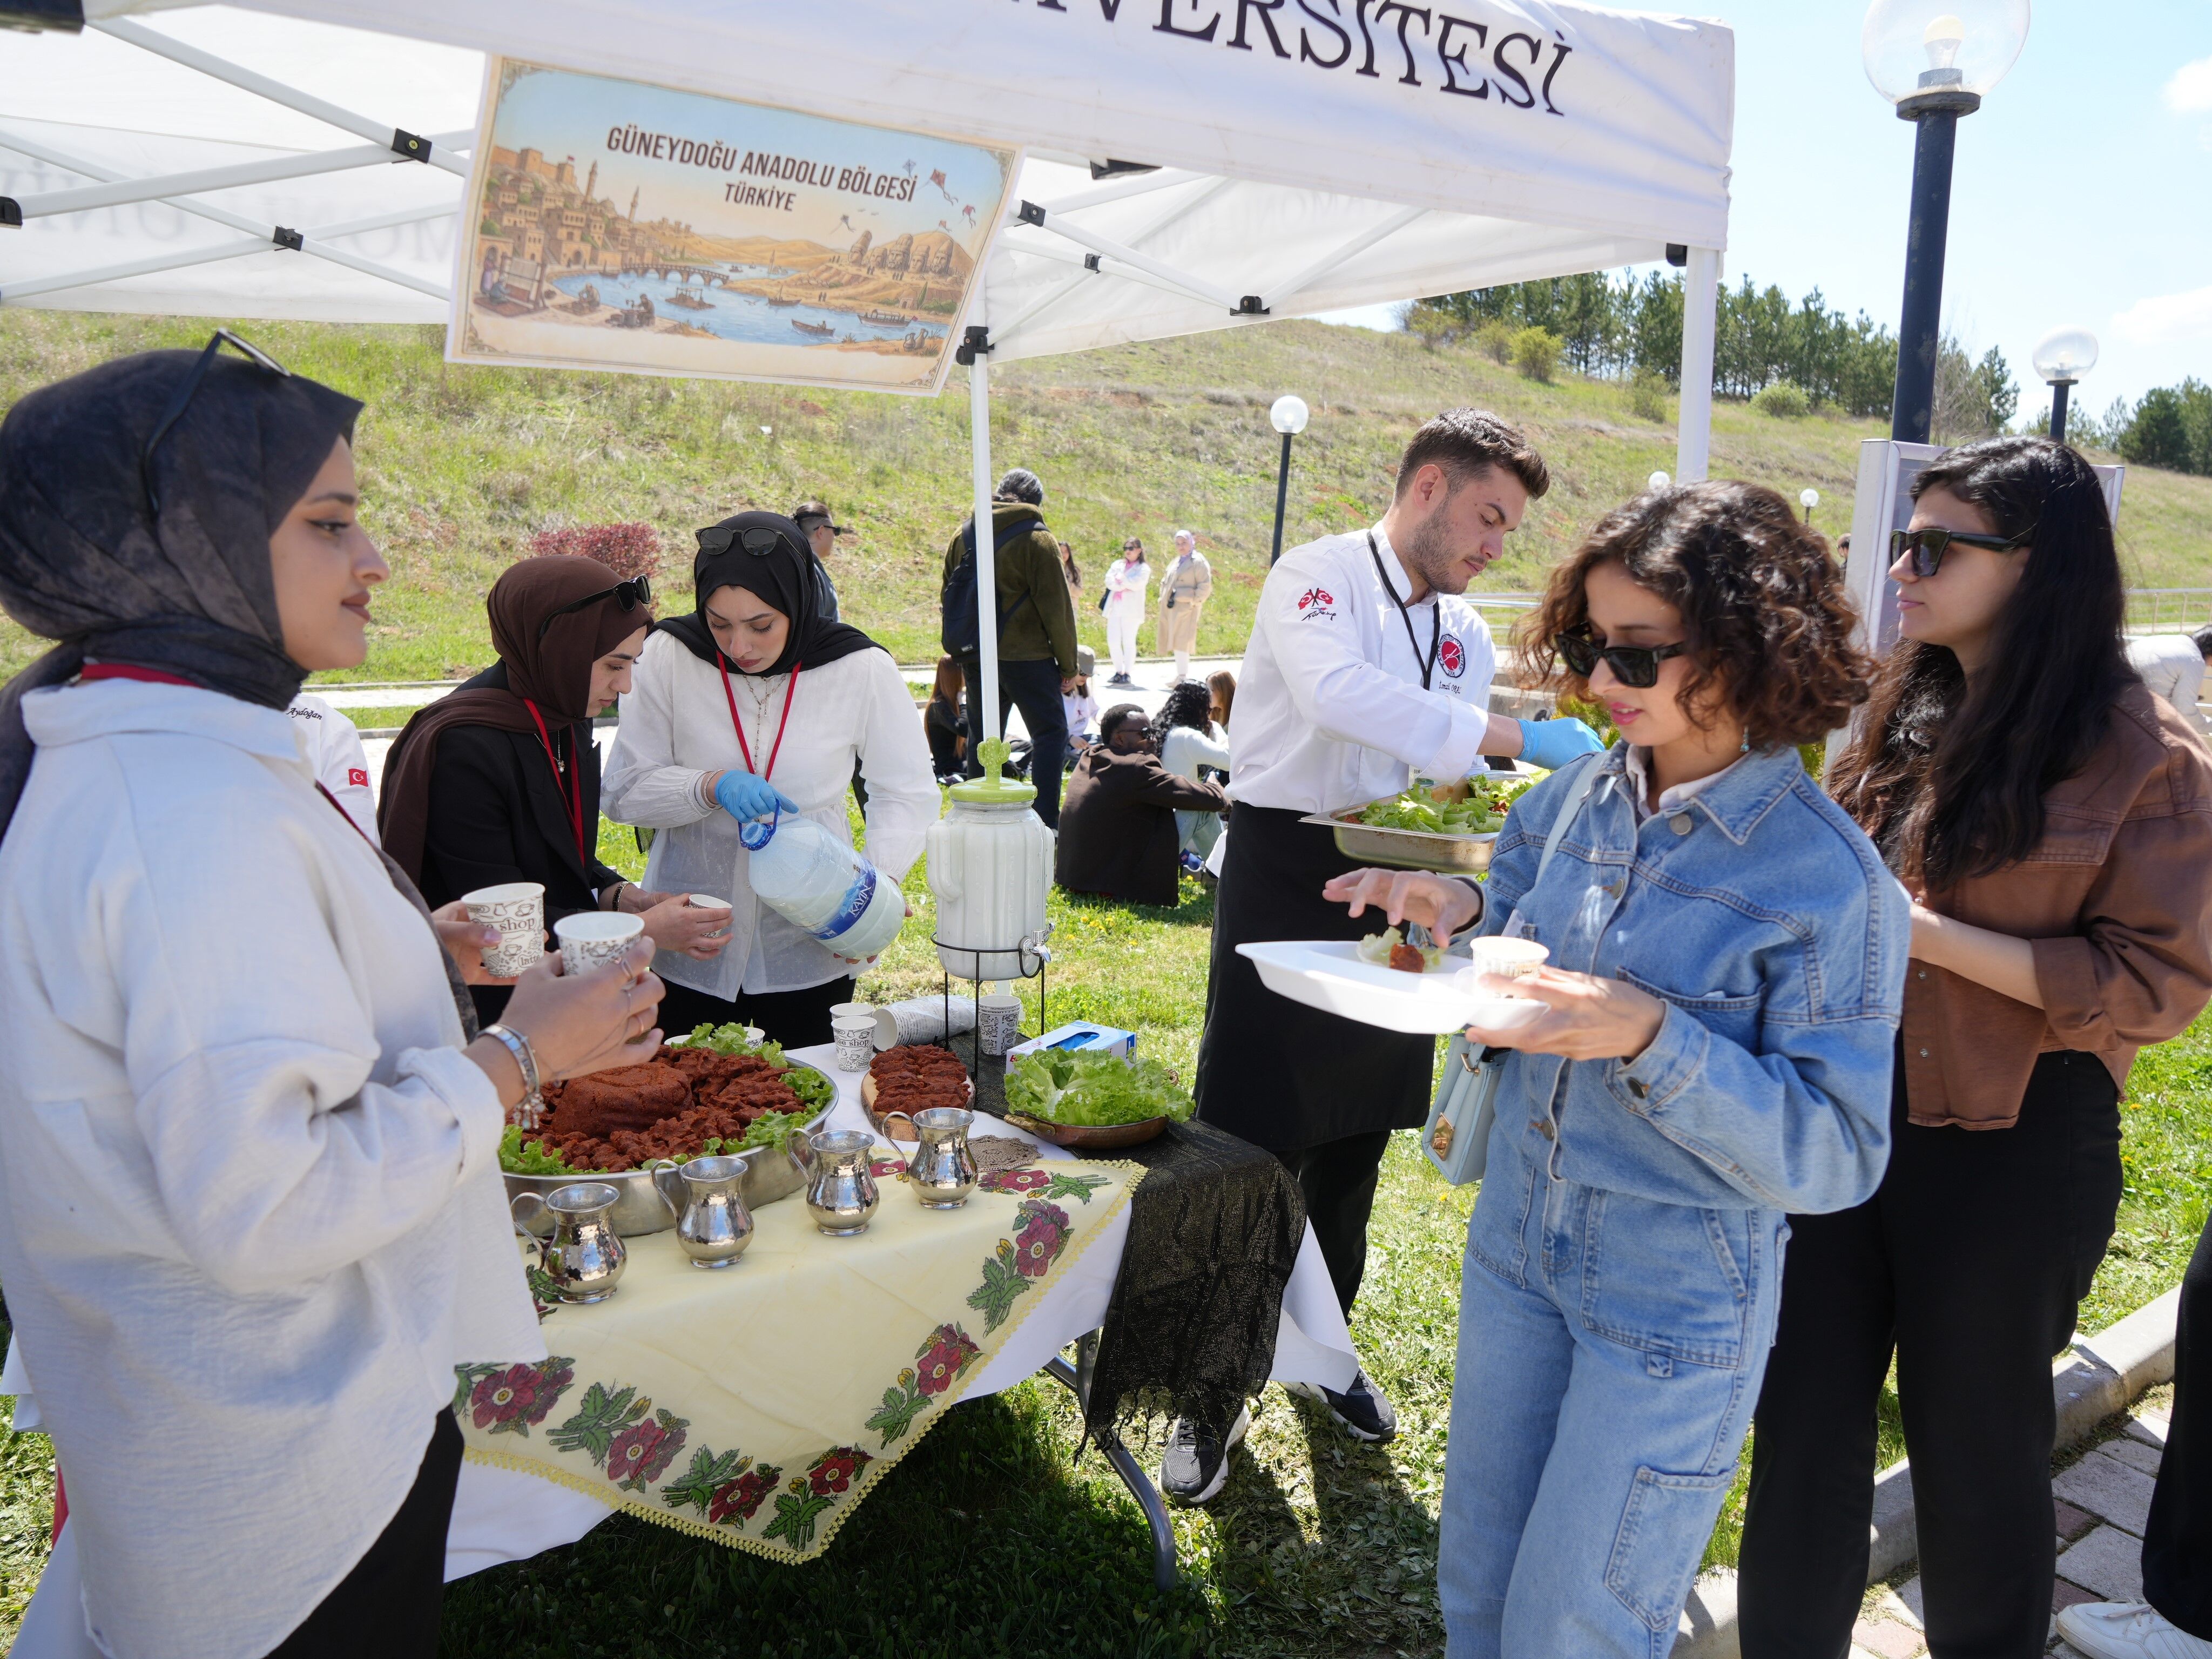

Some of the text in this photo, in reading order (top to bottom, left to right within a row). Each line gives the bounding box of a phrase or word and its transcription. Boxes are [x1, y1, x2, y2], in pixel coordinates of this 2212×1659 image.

[606, 124, 919, 203] GÜNEYDOĞU ANADOLU BÖLGESİ
[725, 183, 797, 211] TÜRKİYE
[286, 707, 323, 720] Aydoğan
[848, 884, 872, 916] KAYIN
[500, 918, 535, 932] shop
